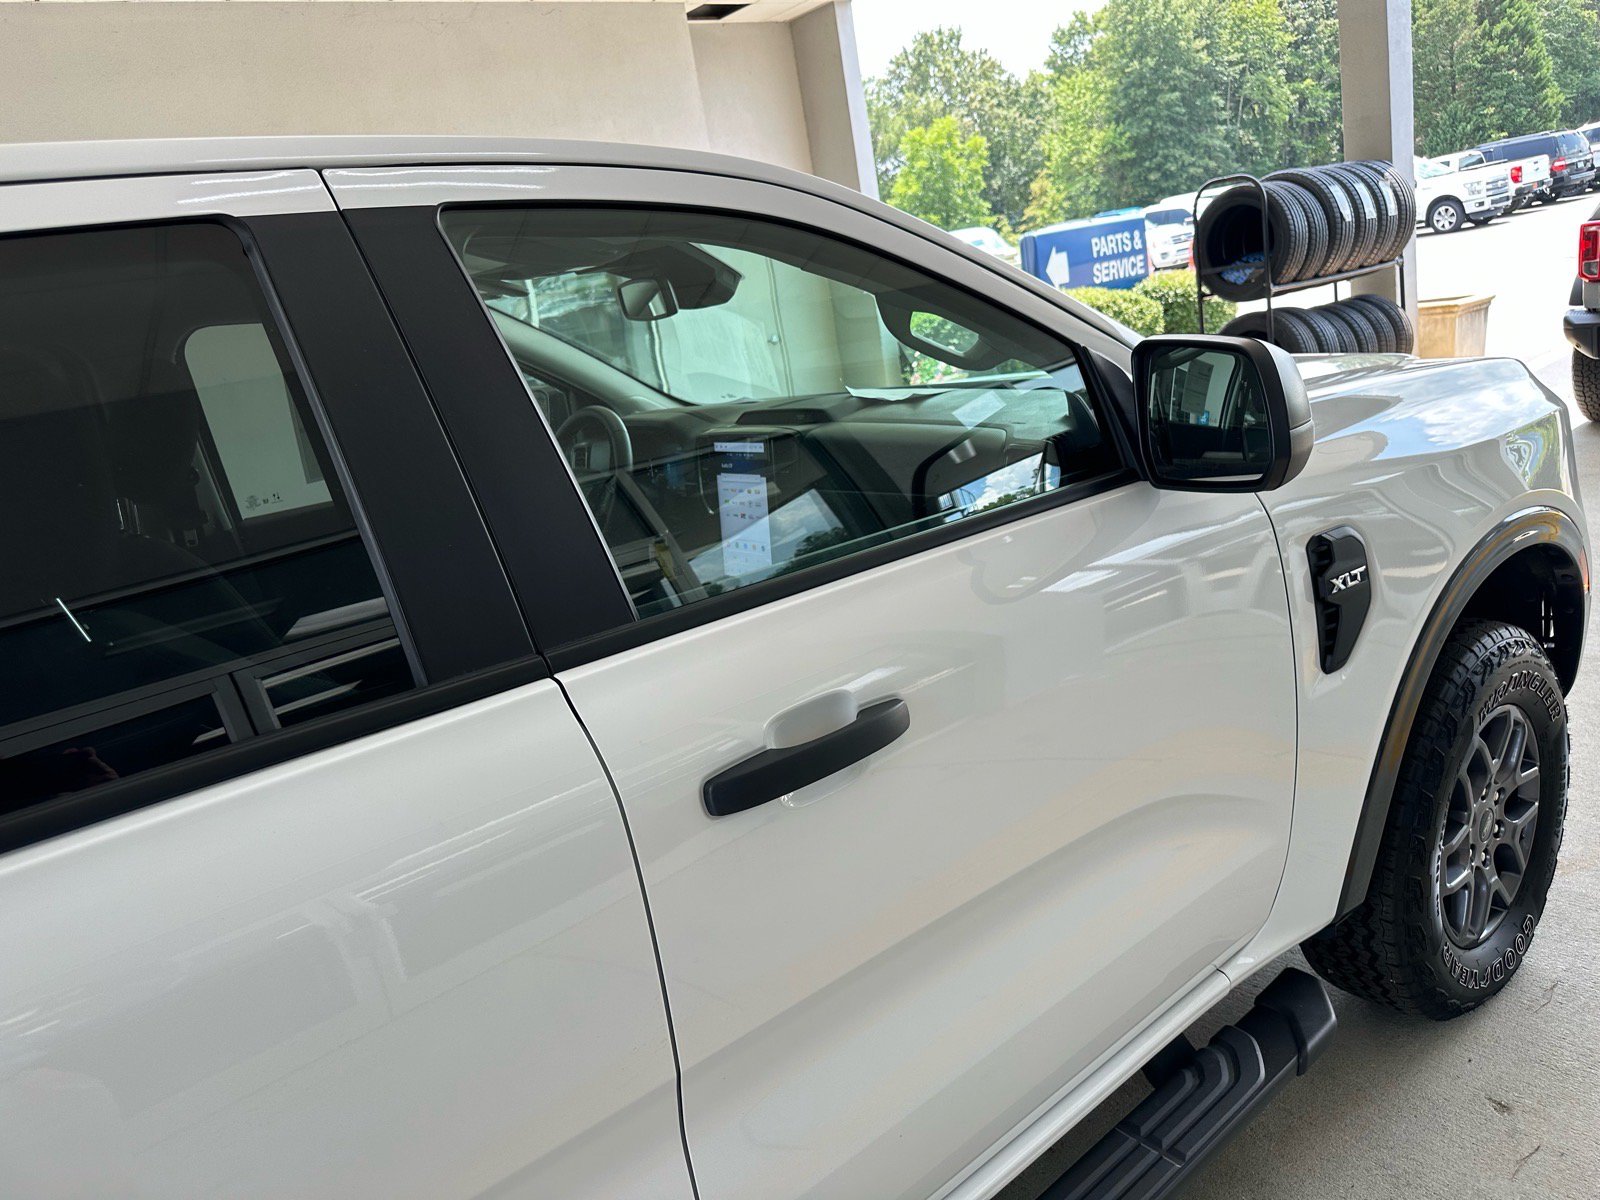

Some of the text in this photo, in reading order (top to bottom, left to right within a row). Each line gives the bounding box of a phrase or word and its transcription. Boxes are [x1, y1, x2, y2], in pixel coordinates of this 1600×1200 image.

[1091, 229, 1143, 258] PARTS &
[1093, 253, 1146, 285] SERVICE
[1330, 565, 1366, 594] XLT
[1478, 669, 1562, 725] WRANGLER
[1443, 914, 1535, 990] GOODYEAR
